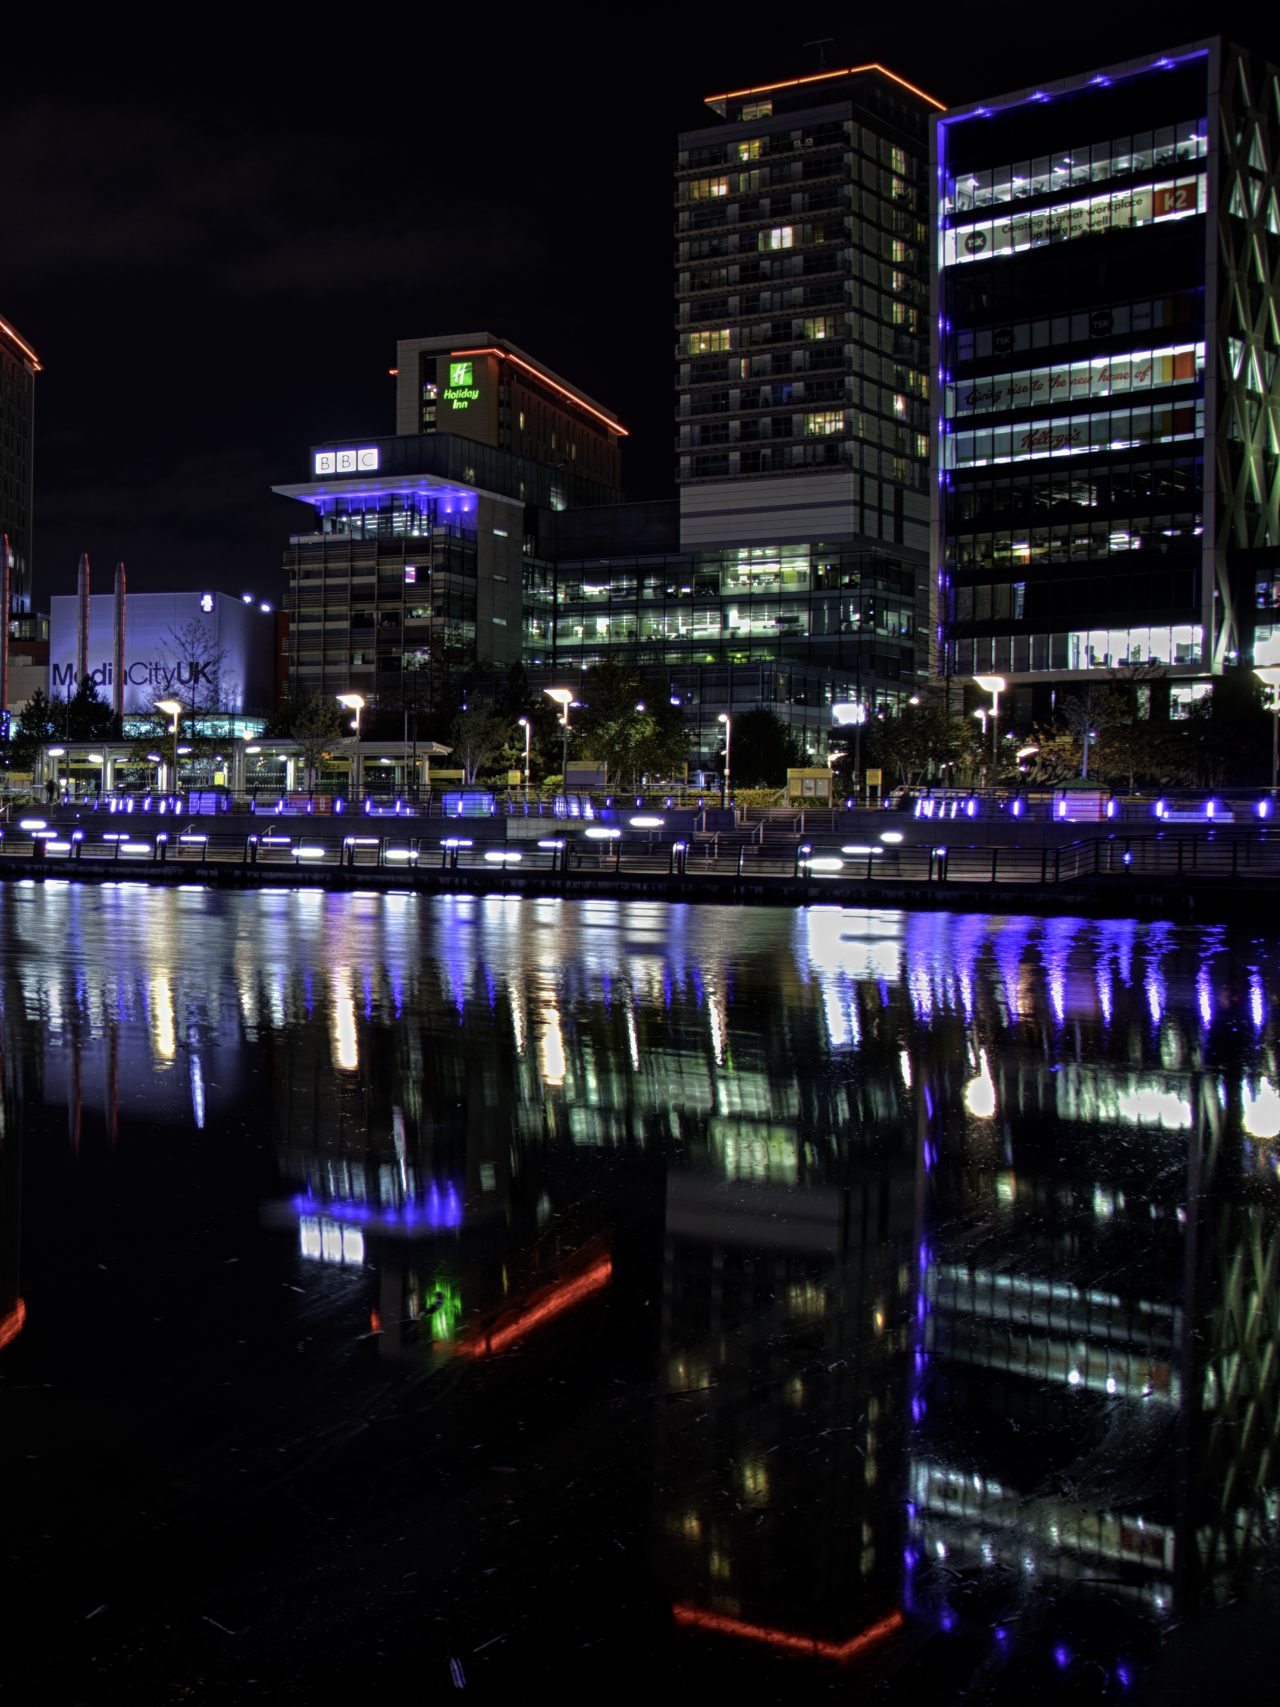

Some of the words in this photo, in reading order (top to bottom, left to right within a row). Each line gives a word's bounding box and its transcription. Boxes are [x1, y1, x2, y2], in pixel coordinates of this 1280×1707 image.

[1001, 218, 1043, 234] Creating
[1056, 210, 1084, 225] great
[1086, 198, 1143, 215] workplace
[1048, 374, 1066, 389] the
[1098, 367, 1130, 383] home
[443, 388, 479, 400] Holiday
[452, 399, 469, 410] Inn
[320, 452, 375, 471] BBC
